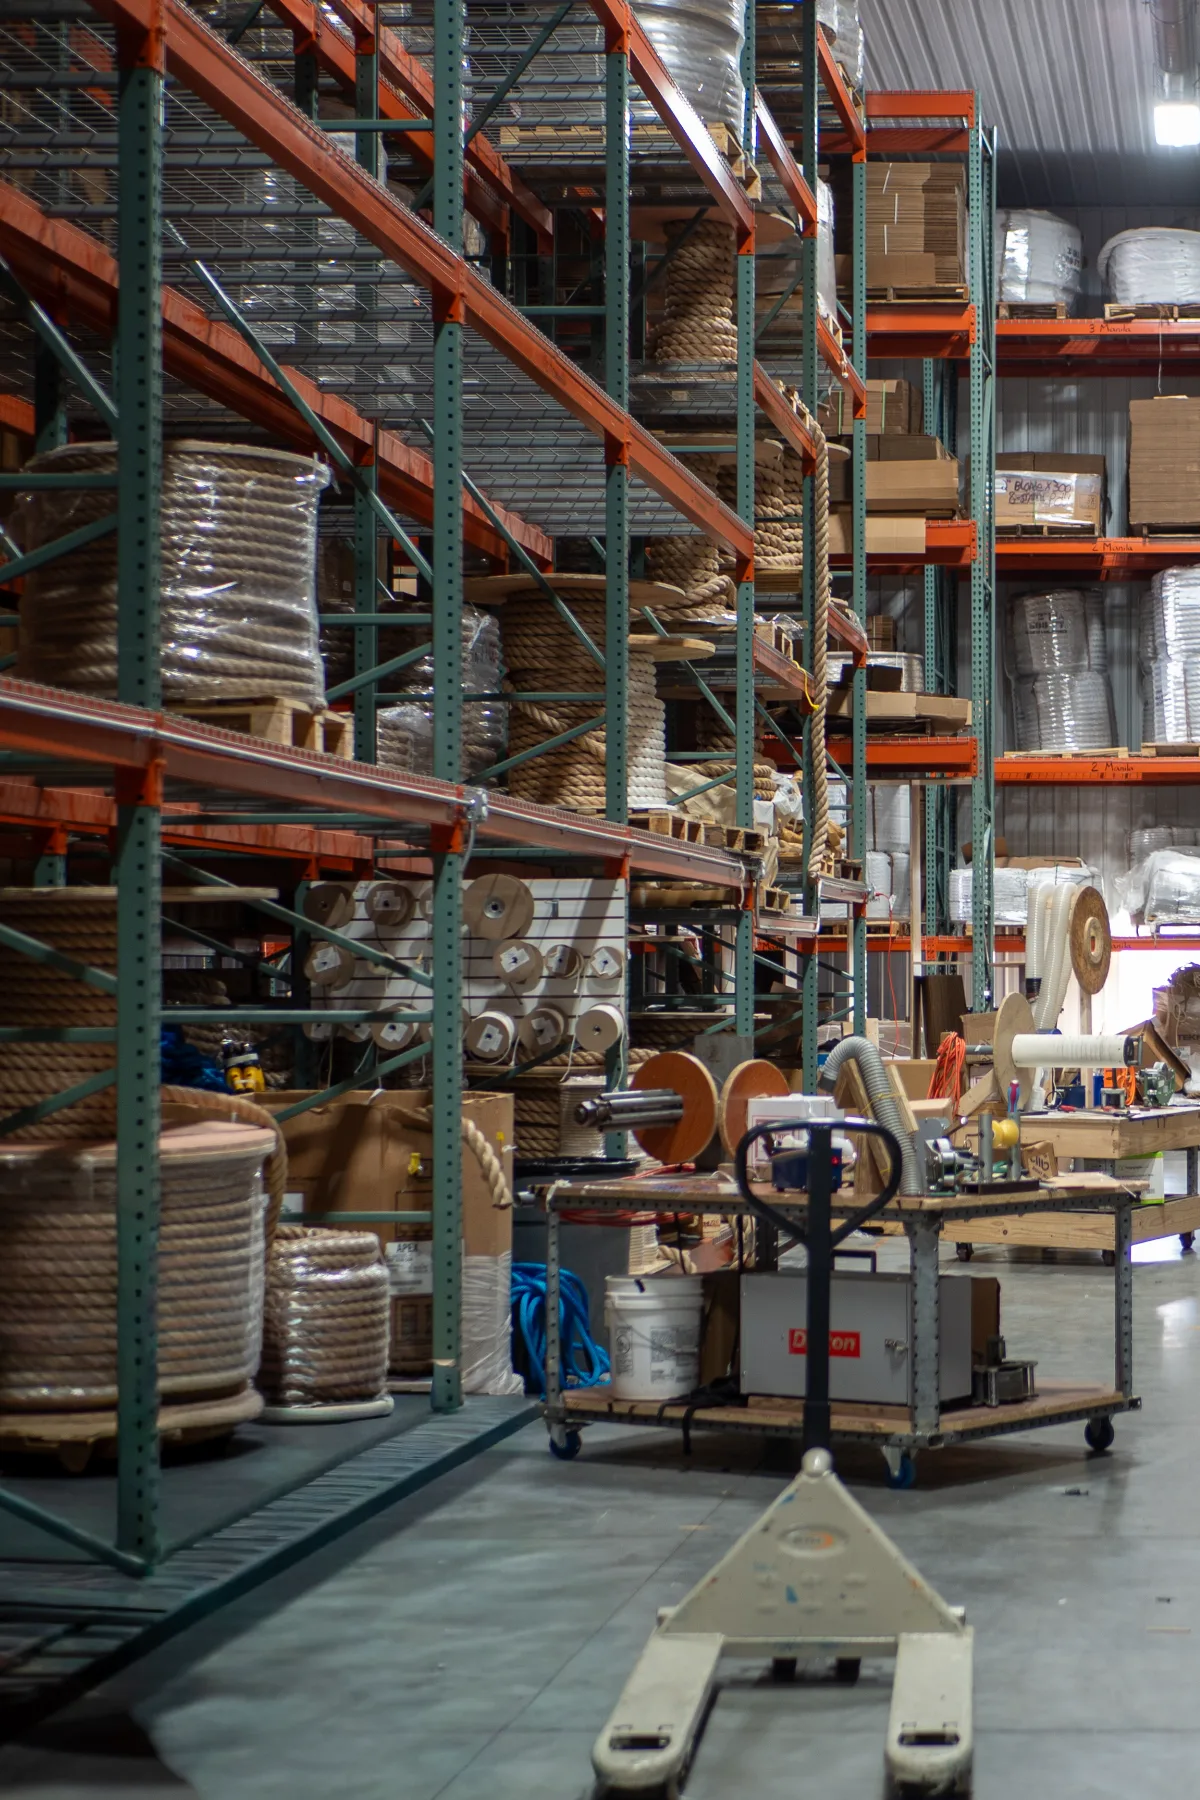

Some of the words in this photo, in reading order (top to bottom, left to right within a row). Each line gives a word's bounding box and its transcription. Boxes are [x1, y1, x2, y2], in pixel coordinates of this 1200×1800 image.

[1089, 323, 1095, 333] 3
[1100, 323, 1131, 333] Manila
[1102, 542, 1133, 551] Manila
[1091, 761, 1098, 772] 2
[1104, 760, 1134, 771] Manila
